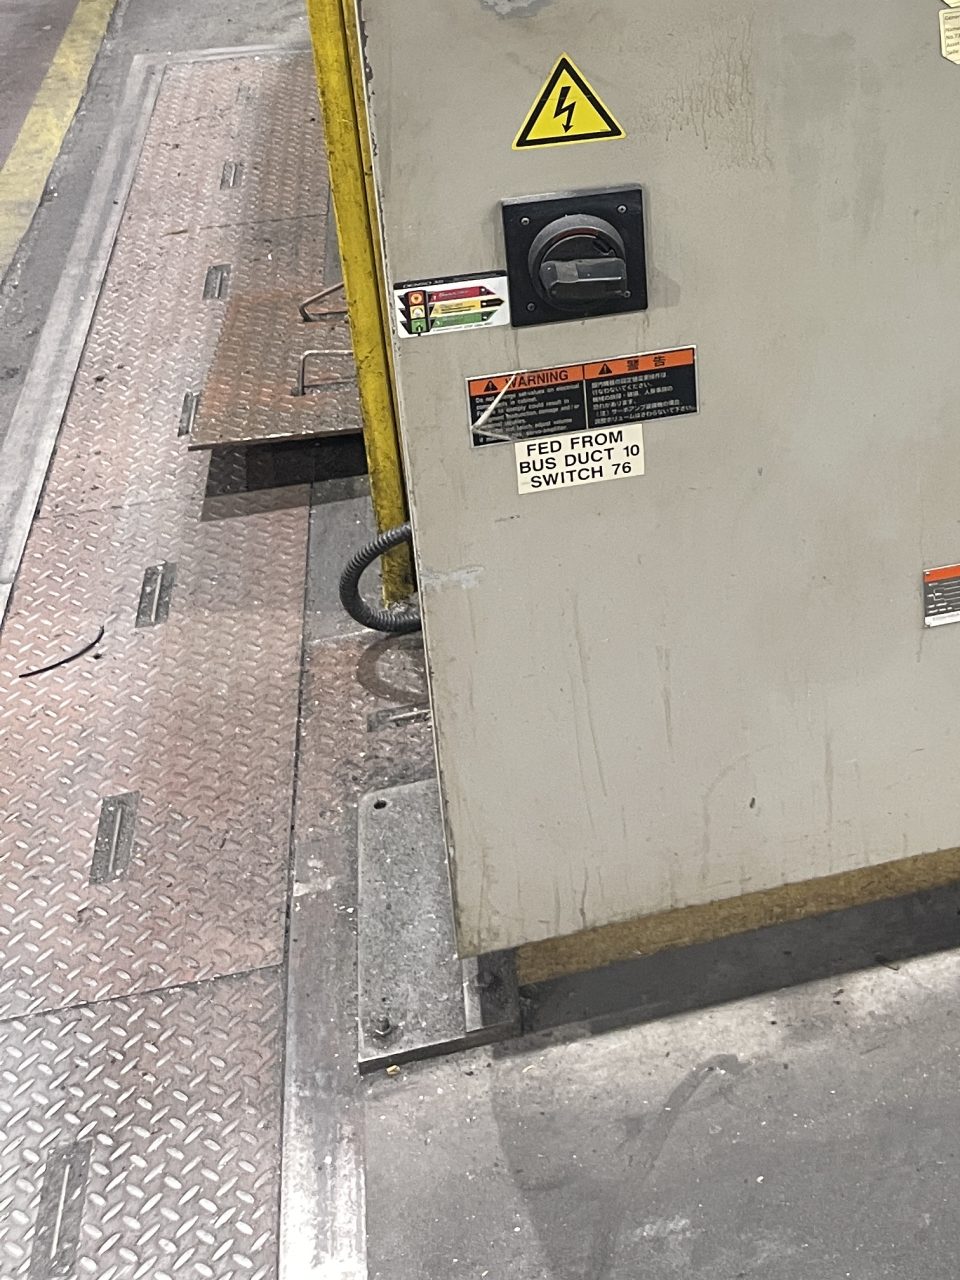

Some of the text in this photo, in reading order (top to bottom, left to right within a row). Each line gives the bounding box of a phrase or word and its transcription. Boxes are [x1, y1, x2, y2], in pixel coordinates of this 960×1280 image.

[505, 370, 568, 389] WARNING
[527, 431, 623, 457] FED FROM
[520, 444, 640, 474] BUS DUCT 10
[531, 462, 632, 488] SWITCH 76
